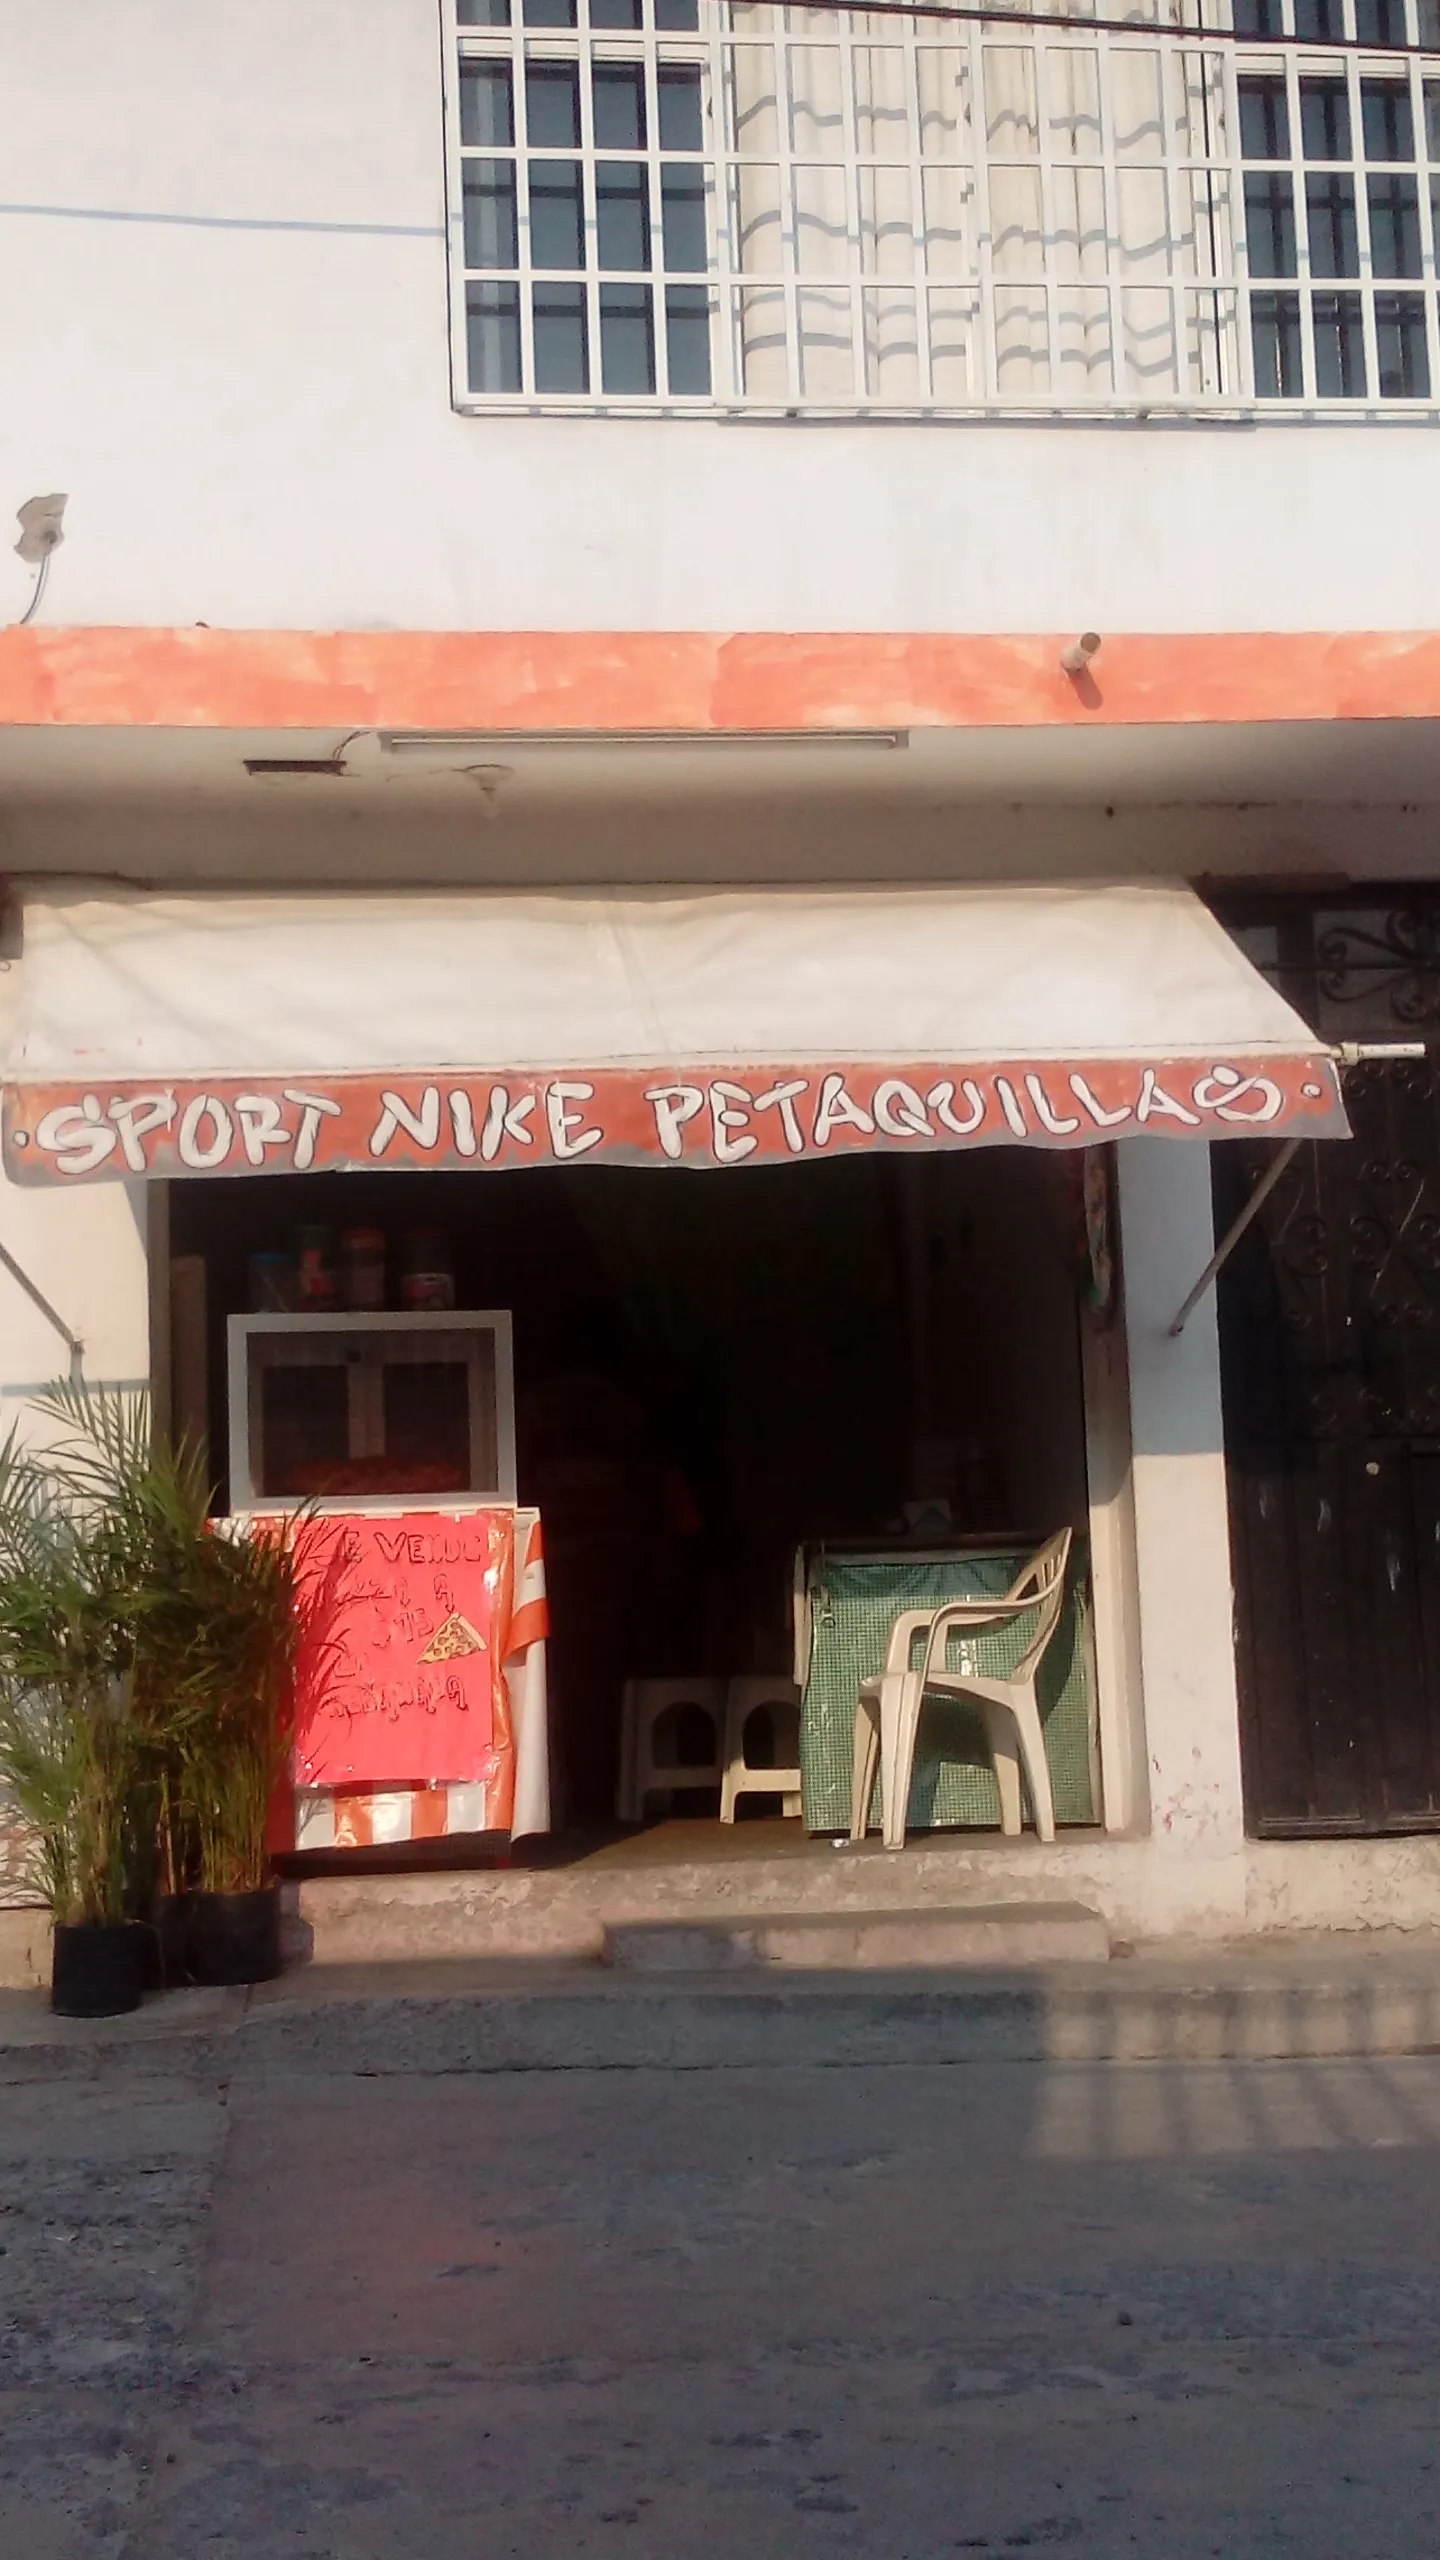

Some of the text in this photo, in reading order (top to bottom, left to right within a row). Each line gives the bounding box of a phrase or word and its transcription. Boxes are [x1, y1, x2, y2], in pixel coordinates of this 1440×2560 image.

[36, 1064, 1284, 1173] SPORT NIKE PETAQUILLAS
